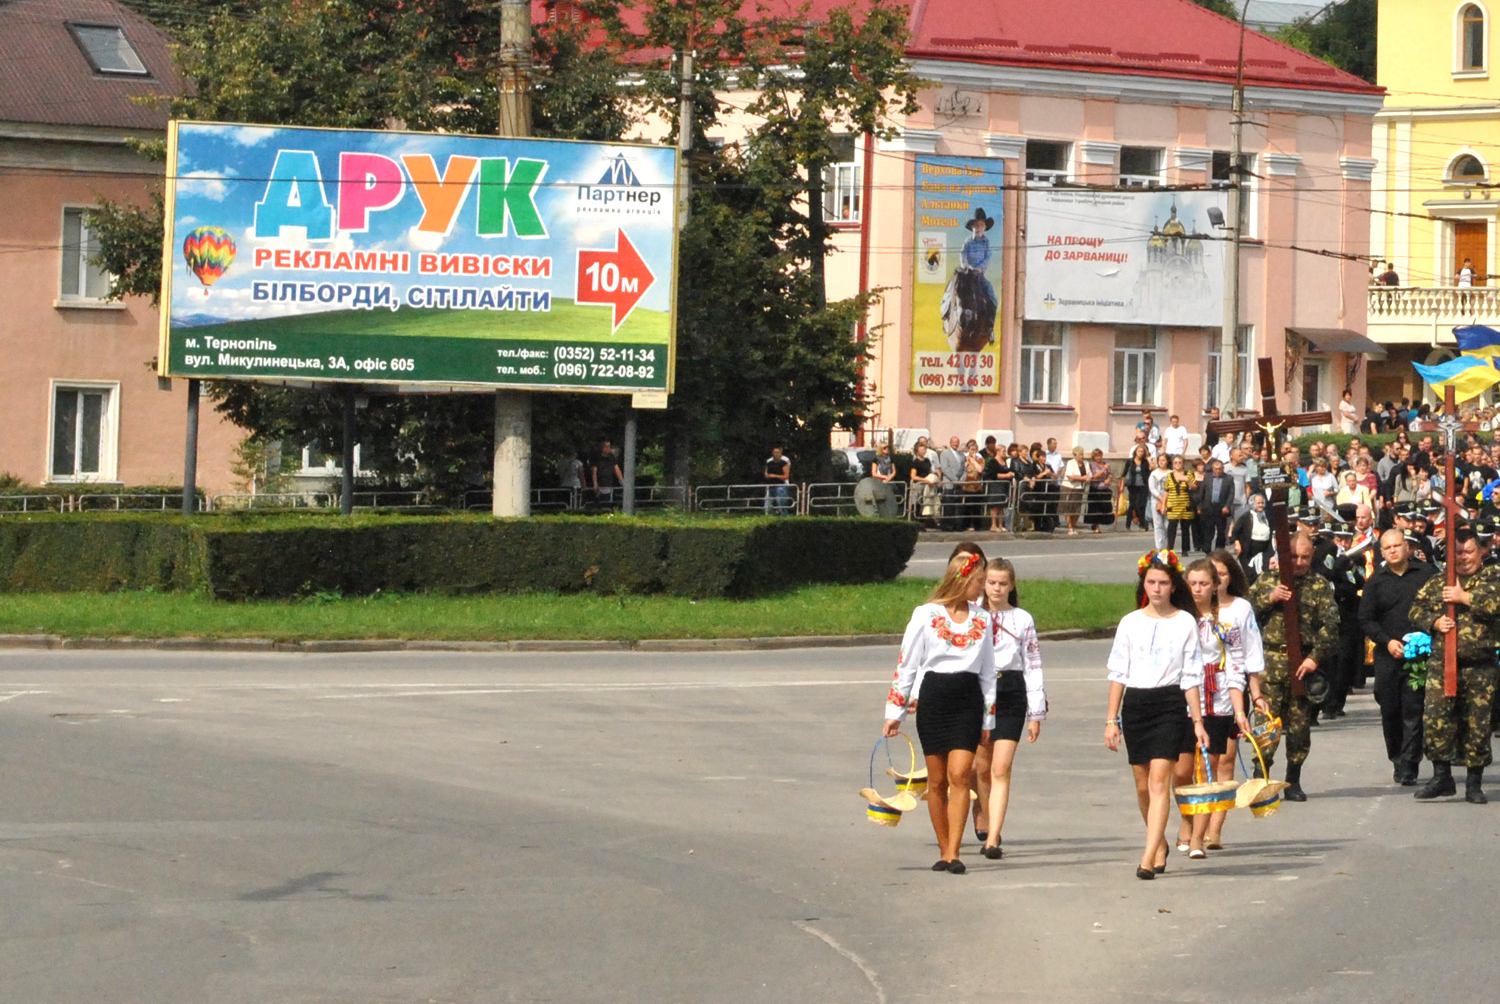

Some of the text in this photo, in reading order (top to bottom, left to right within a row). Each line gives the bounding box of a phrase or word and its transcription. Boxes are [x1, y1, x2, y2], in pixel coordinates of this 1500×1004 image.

[254, 149, 549, 242] ДРУК
[578, 184, 662, 206] Партнер
[1047, 235, 1104, 248] НА ПРОЩУ
[254, 248, 551, 277] РЕКЛАМНІ ВИВІСКИ
[1044, 250, 1129, 264] ДО ЗАРВАНИЦІ!
[252, 282, 550, 311] БІЛБОРДИ, СІТІЛАЙТИ
[185, 336, 278, 351] м. Тернопіль
[185, 354, 214, 366] вул.
[218, 353, 324, 370] Микулинецька,
[354, 357, 387, 371] офіс
[390, 358, 415, 371] 605
[497, 346, 655, 362] тел./факс: (0352) 52-11-34
[919, 353, 994, 369] тел. 42 03 30
[497, 362, 655, 379] тел. моб.: (096) 722-08-92
[918, 372, 993, 389] (098) 575 66 30
